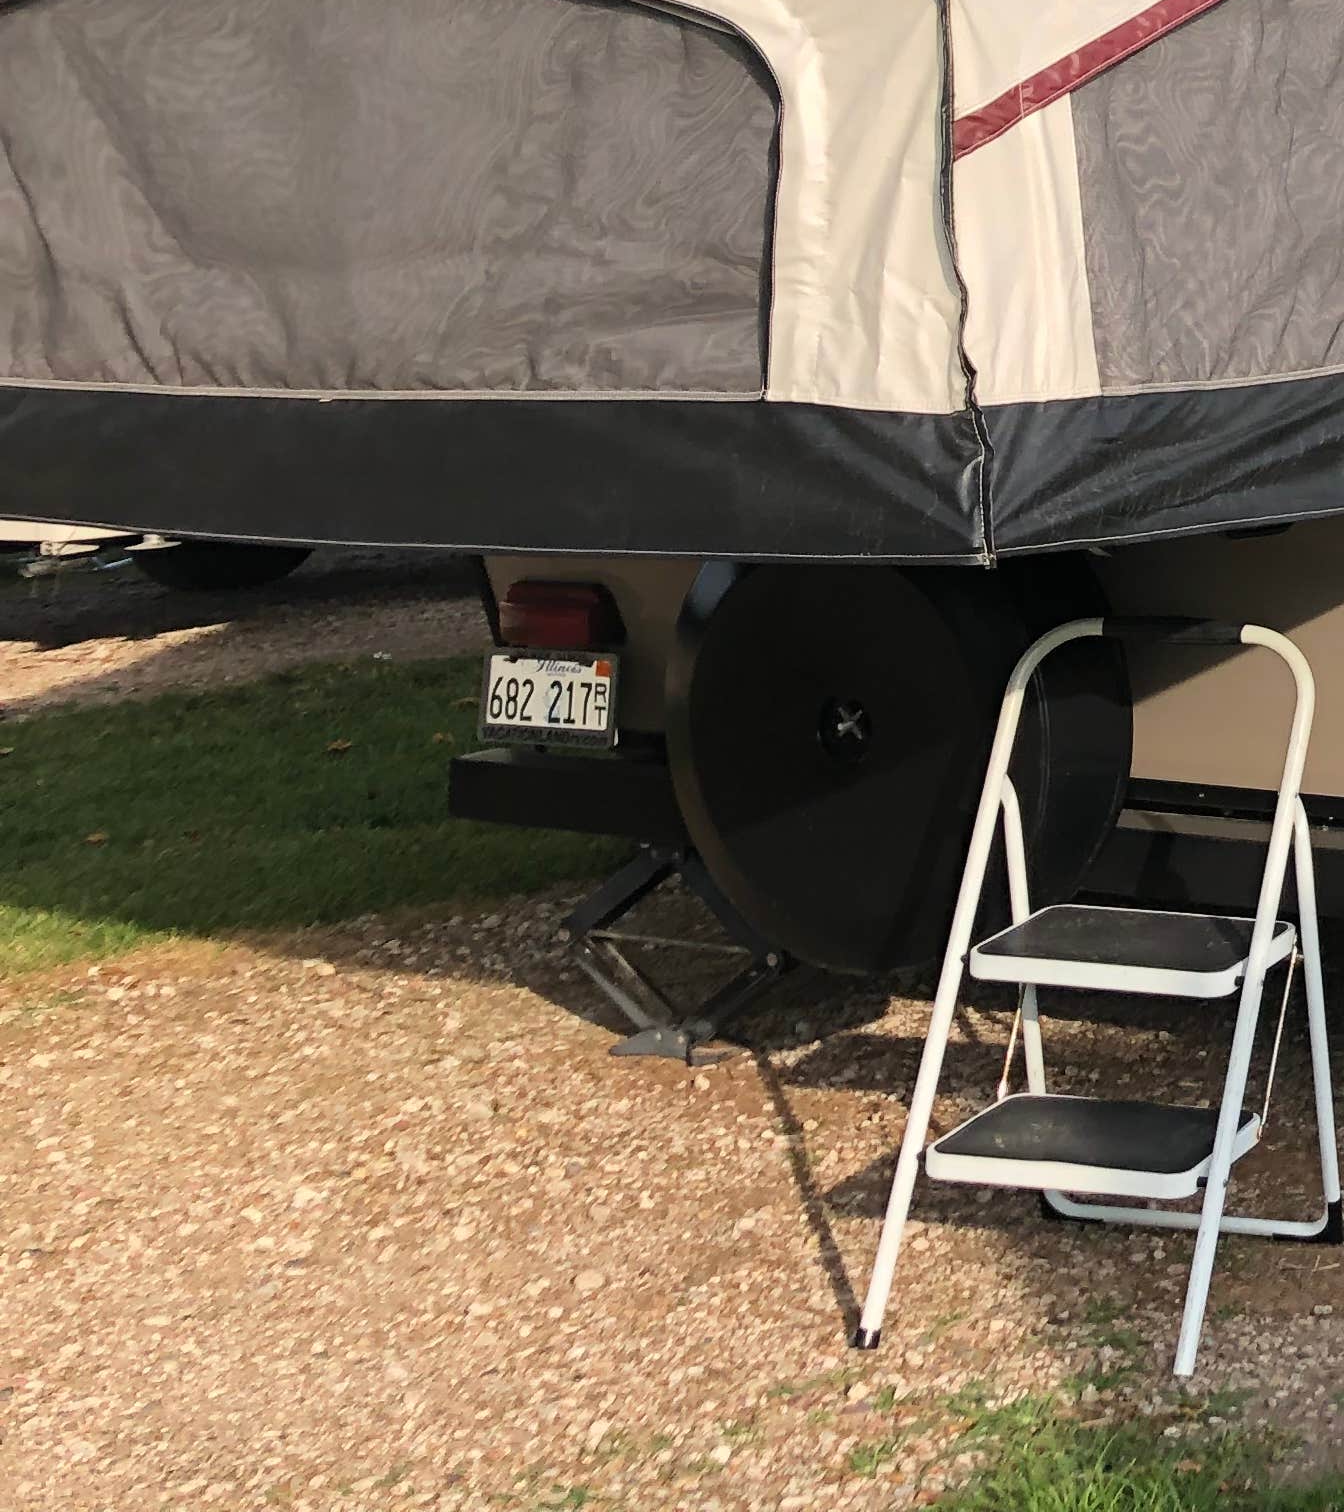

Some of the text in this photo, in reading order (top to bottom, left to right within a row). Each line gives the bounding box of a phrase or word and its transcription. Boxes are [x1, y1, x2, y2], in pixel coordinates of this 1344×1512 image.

[536, 660, 582, 674] Illinois
[489, 676, 535, 721] 682
[548, 680, 592, 725] 217
